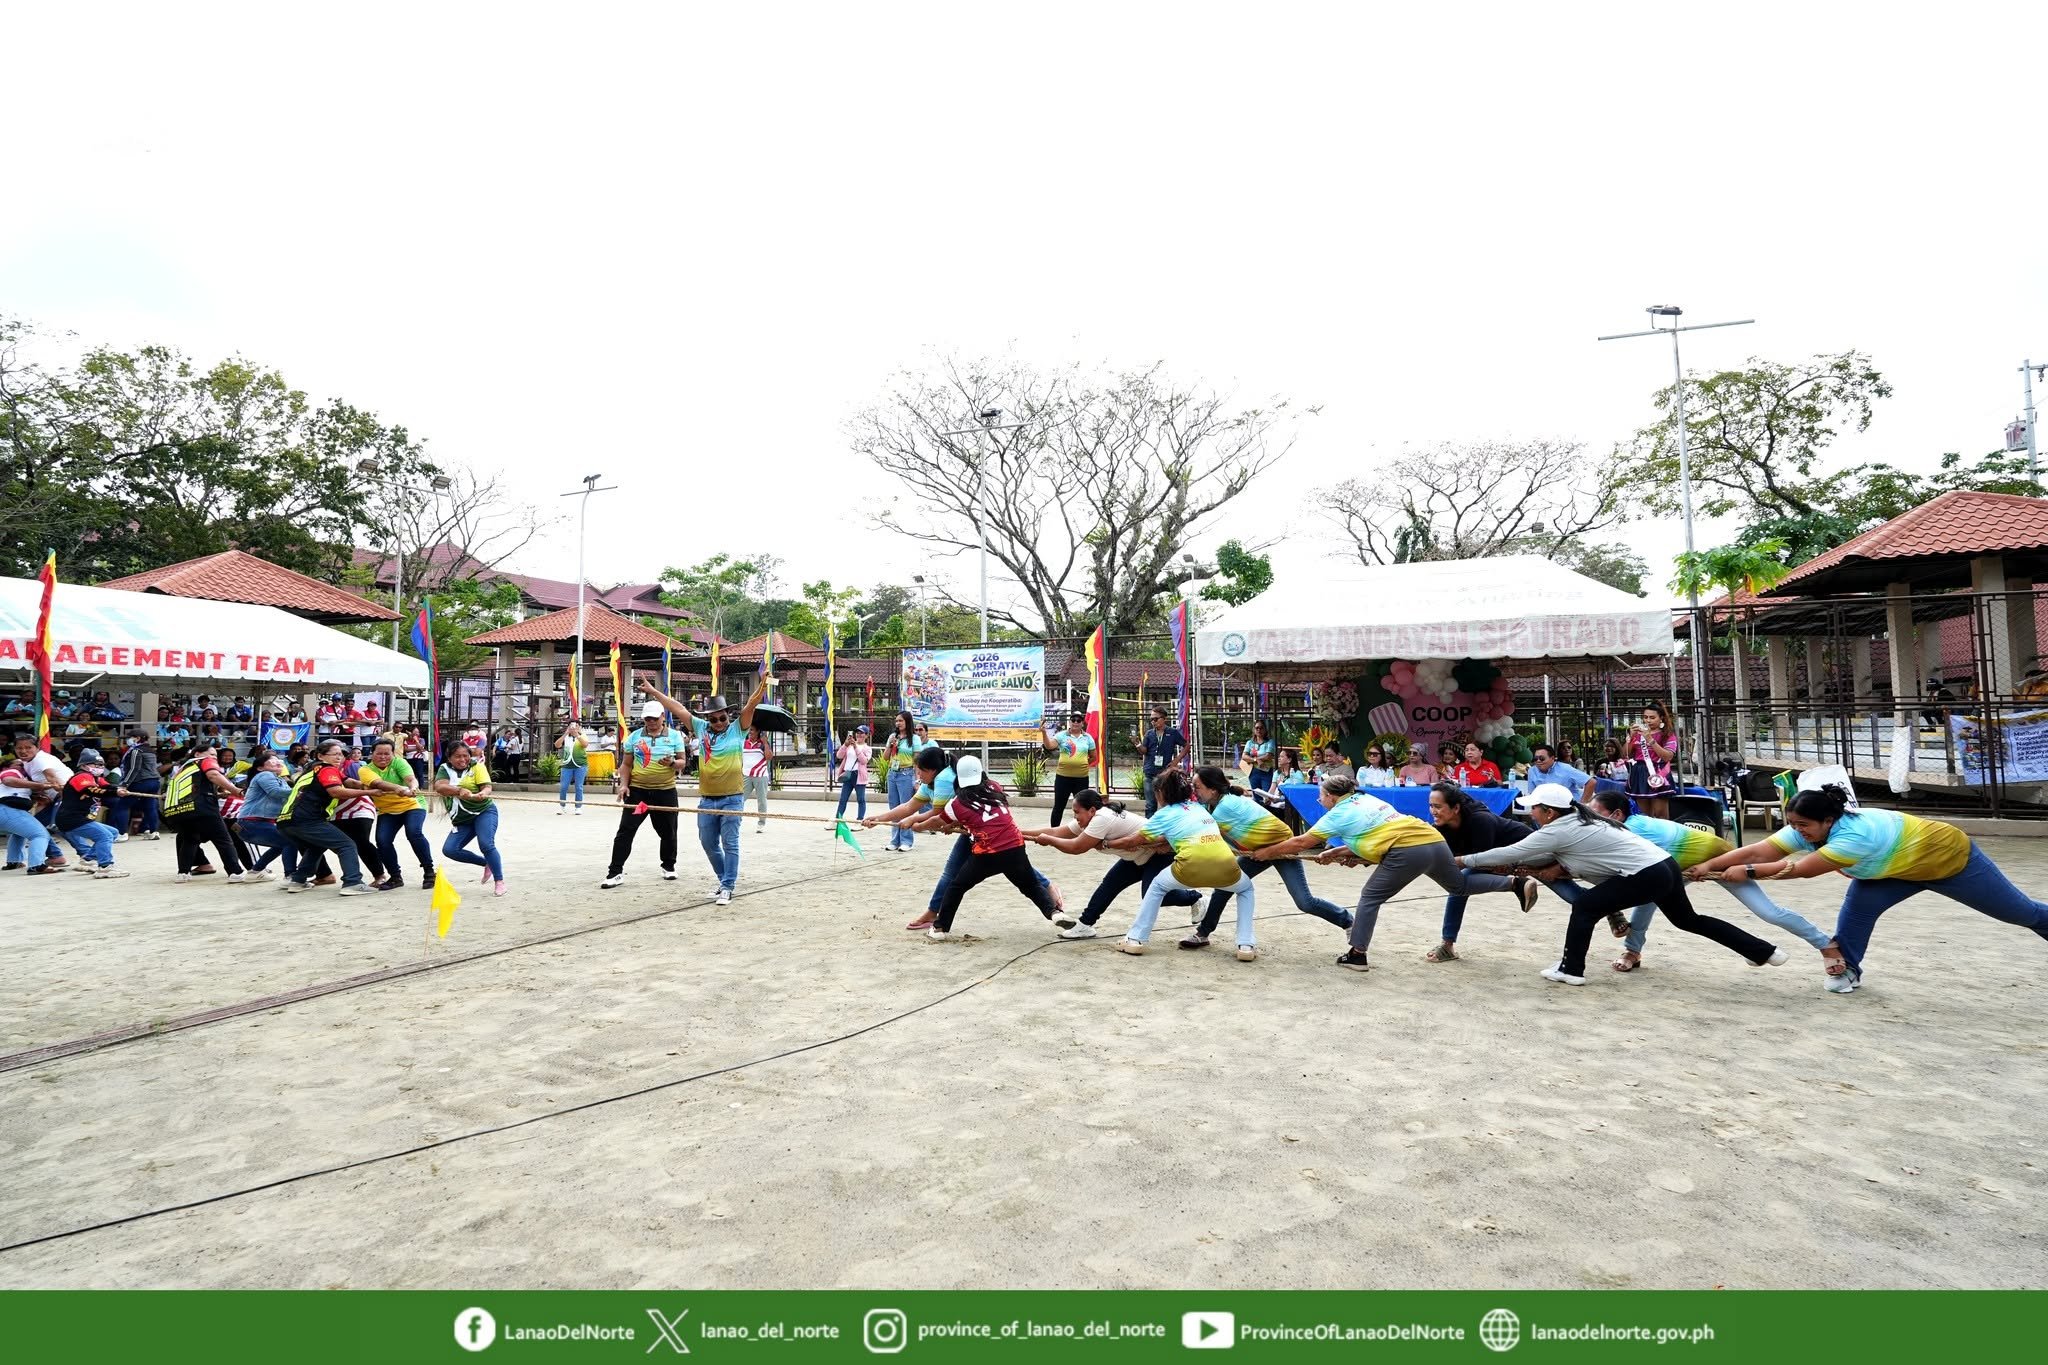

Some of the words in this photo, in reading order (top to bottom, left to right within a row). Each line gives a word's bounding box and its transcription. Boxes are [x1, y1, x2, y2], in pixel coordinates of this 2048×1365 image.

[237, 654, 315, 675] TEAM
[972, 653, 1000, 662] 2026
[954, 661, 1030, 673] COOPERATIVE
[954, 679, 998, 691] OPENING
[1001, 676, 1033, 689] SALVO
[1412, 706, 1472, 721] COOP
